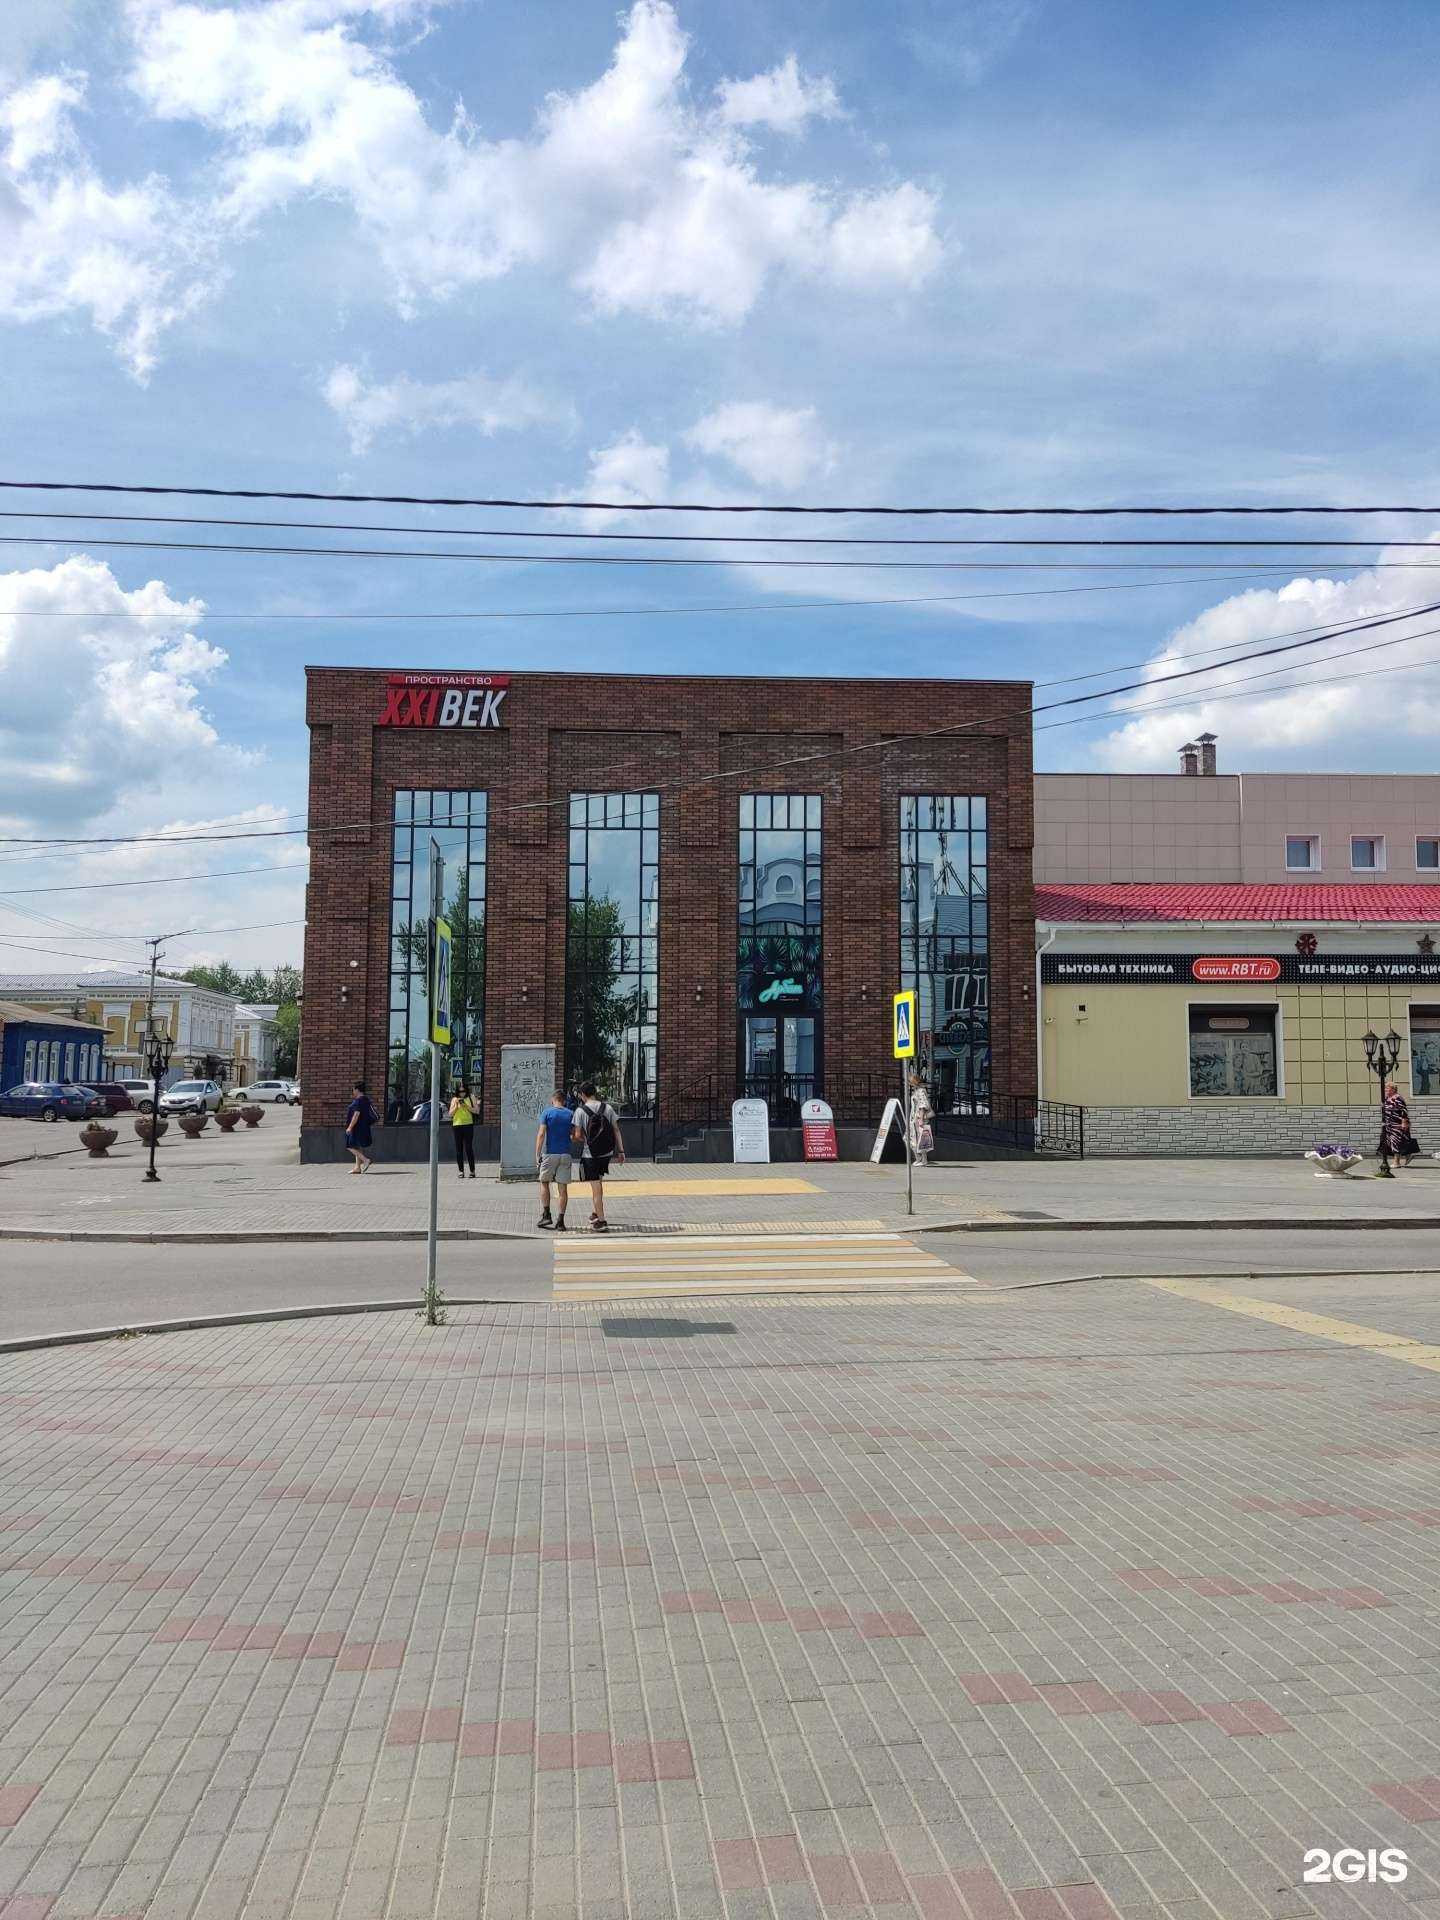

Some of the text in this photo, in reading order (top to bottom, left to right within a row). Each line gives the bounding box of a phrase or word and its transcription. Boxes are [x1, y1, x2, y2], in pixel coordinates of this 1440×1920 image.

[405, 675, 492, 685] ПРОСТРАНСТВО
[439, 689, 507, 727] ВЕК
[1058, 964, 1175, 974] БЫТОВАЯ ТЕХНИКА
[1199, 963, 1274, 976] www.RBT.ru
[1299, 964, 1440, 976] ТЕЛЕ-ВИДЕО-АУДИО-ЦИ
